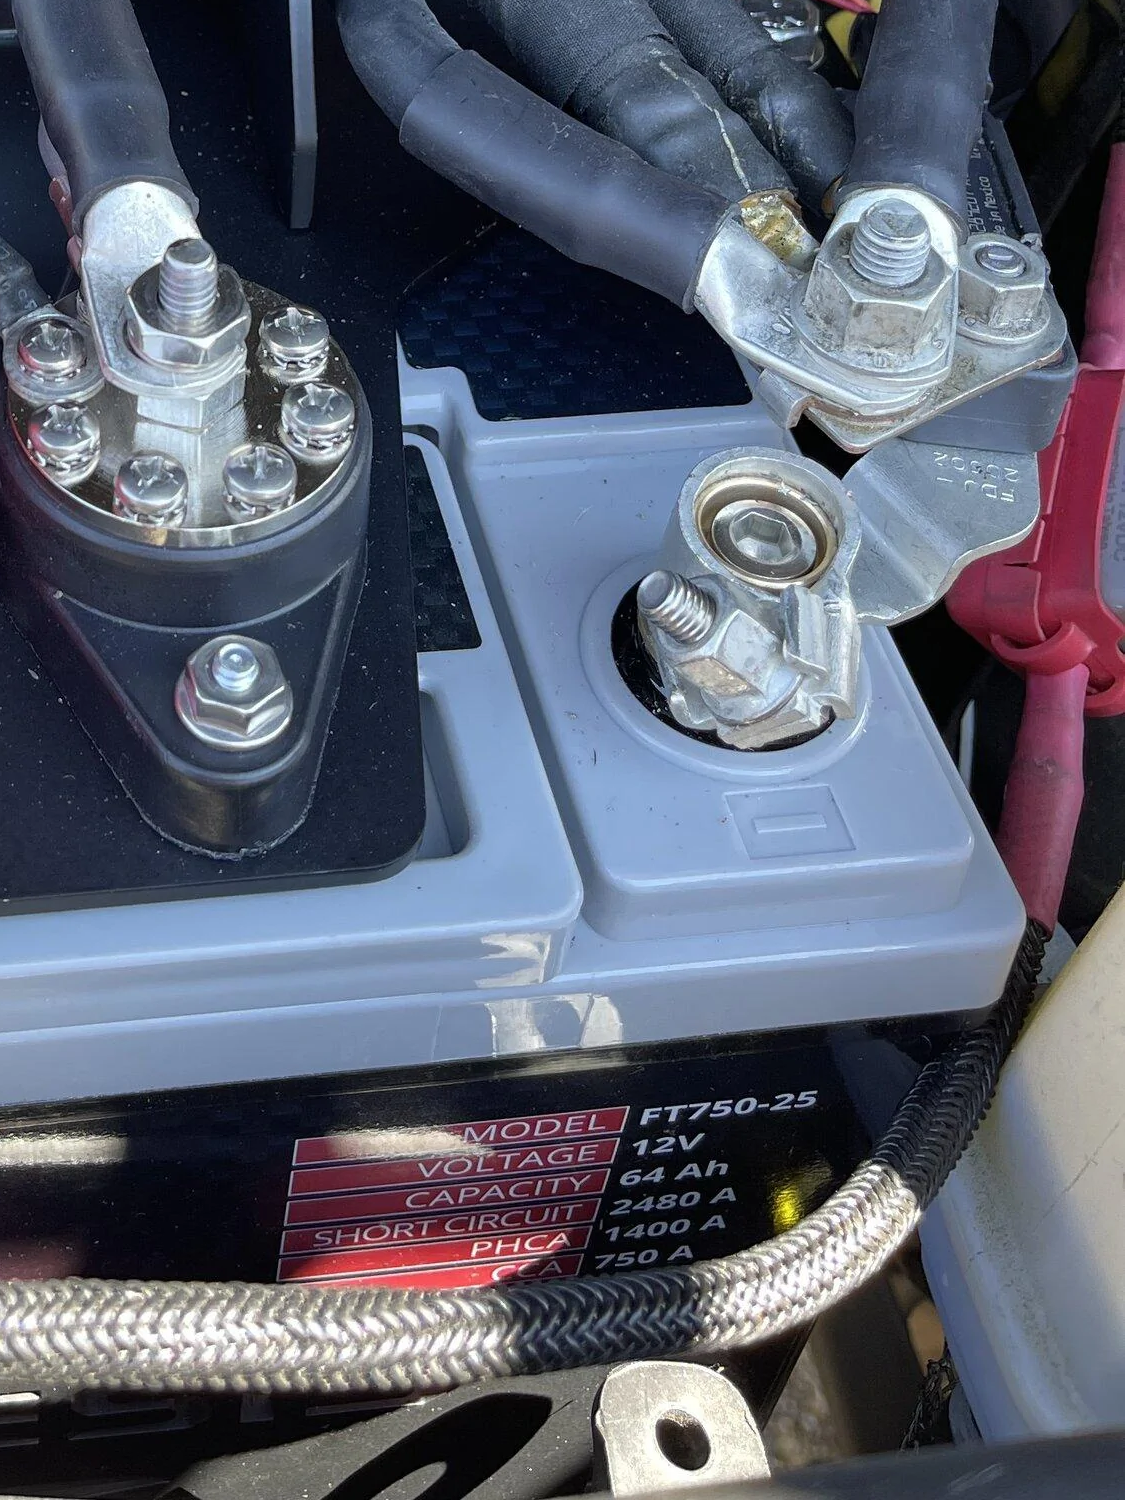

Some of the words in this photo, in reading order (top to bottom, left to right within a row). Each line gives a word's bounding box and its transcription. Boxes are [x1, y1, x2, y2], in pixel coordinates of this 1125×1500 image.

[977, 175, 999, 210] Mexico
[463, 1113, 606, 1143] MODEL
[639, 1090, 819, 1127] FT750-25
[417, 1145, 597, 1178] VOLTAGE
[632, 1132, 705, 1156] 12V
[405, 1174, 592, 1209] CAPACITY
[619, 1166, 665, 1186] 64
[674, 1160, 729, 1180] Ah
[312, 1219, 437, 1248] SHORT
[444, 1203, 583, 1234] CIRCUIT
[609, 1191, 701, 1216] 2480
[709, 1187, 737, 1204] A
[470, 1231, 572, 1258] PHCA
[605, 1219, 691, 1242] 1400
[699, 1214, 726, 1232] A
[490, 1260, 563, 1282] CCA
[594, 1249, 659, 1270] 750
[667, 1245, 694, 1261] A
